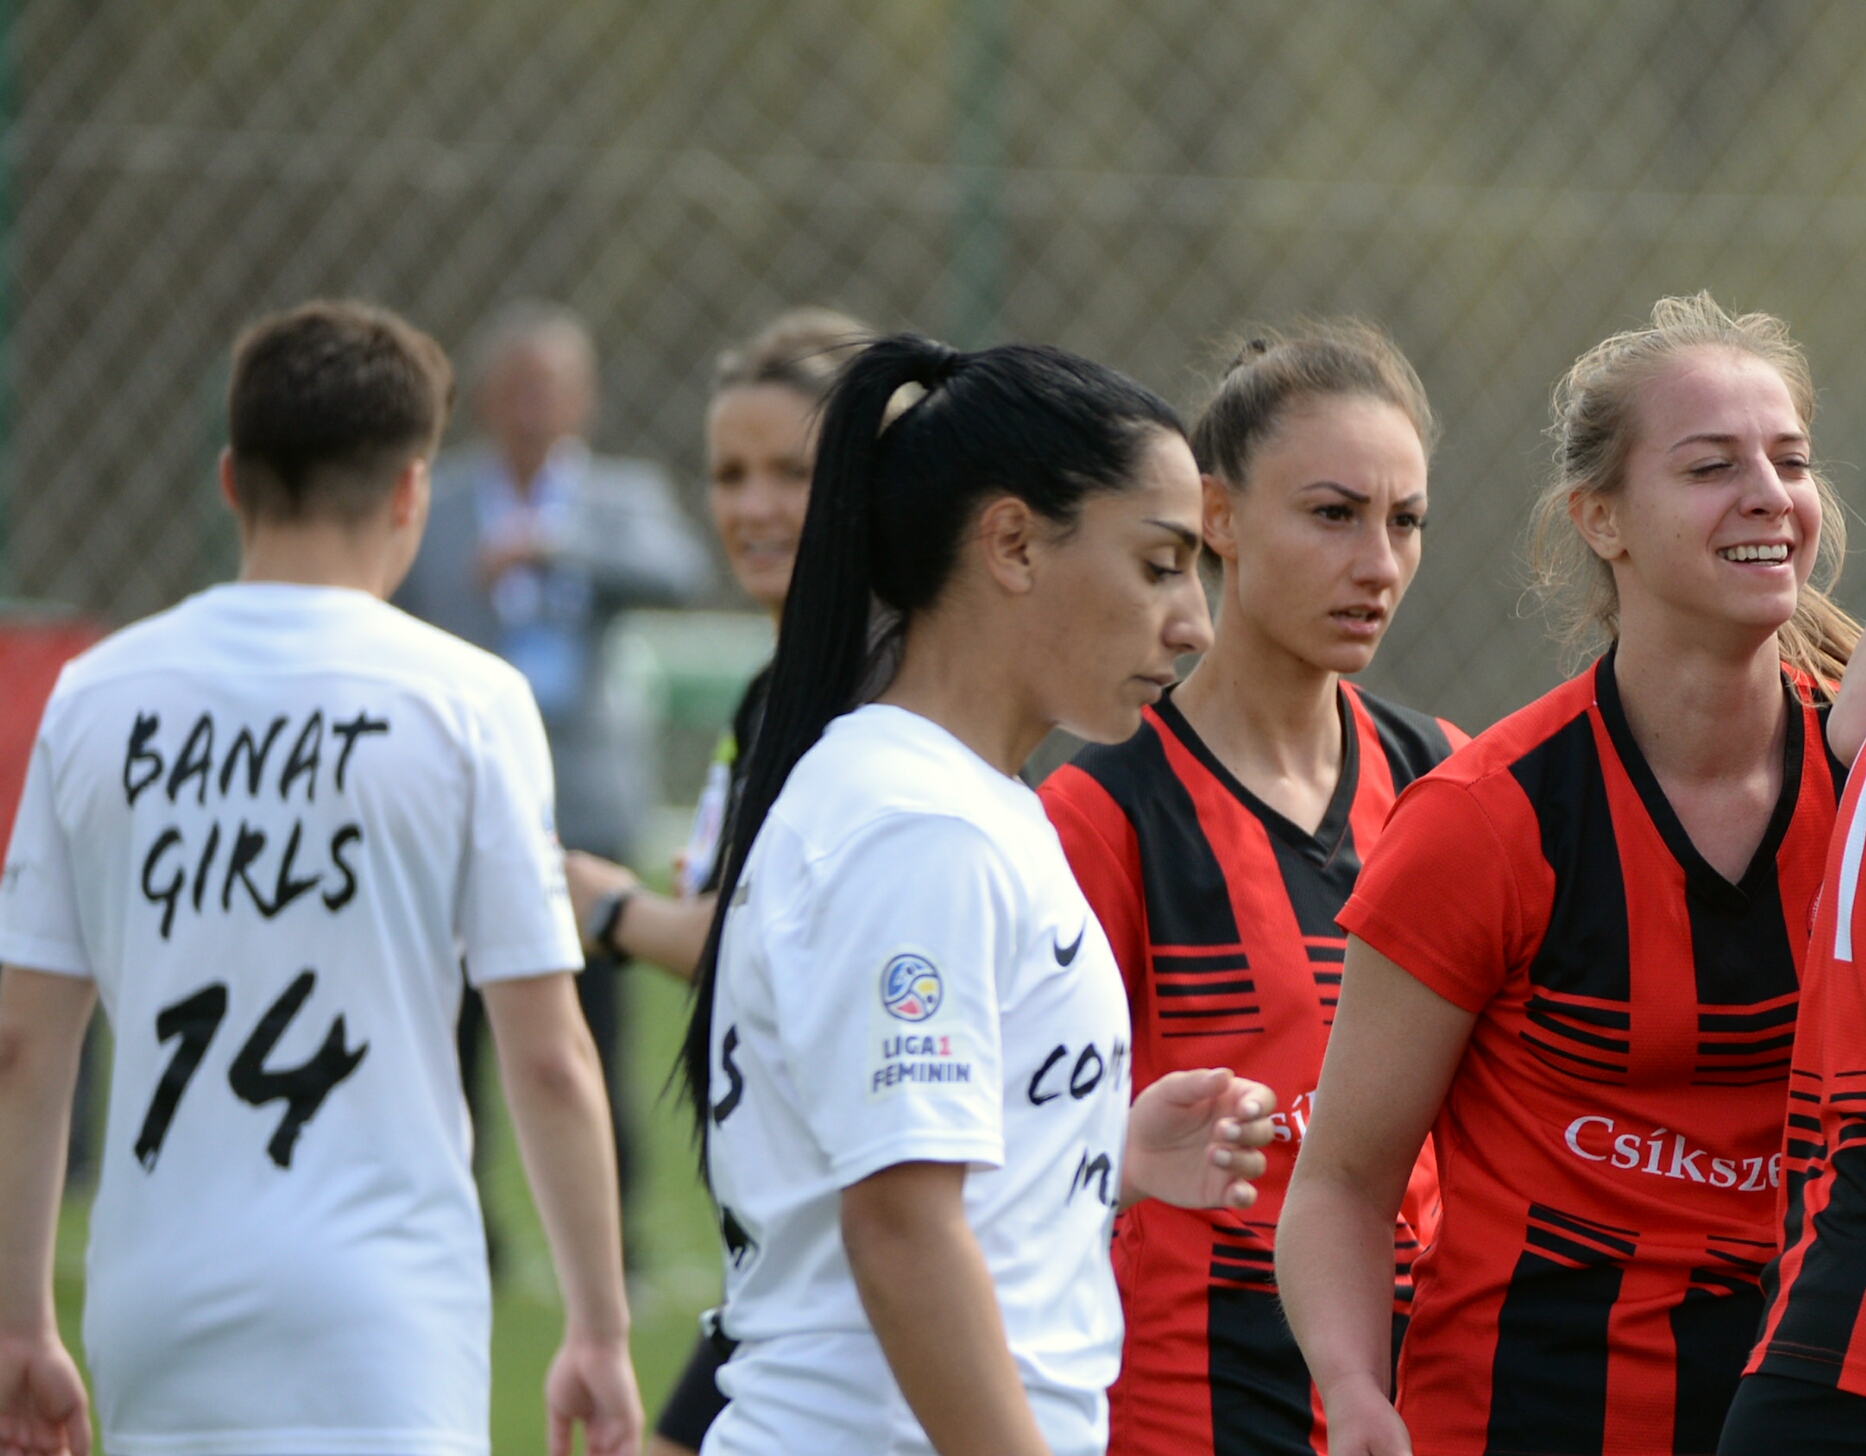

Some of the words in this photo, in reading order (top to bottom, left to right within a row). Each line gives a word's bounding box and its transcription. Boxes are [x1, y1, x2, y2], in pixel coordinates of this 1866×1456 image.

[121, 709, 389, 807] BANAT
[141, 819, 363, 940] GIRLS
[133, 969, 371, 1175] 14
[872, 1061, 970, 1094] FEMININ
